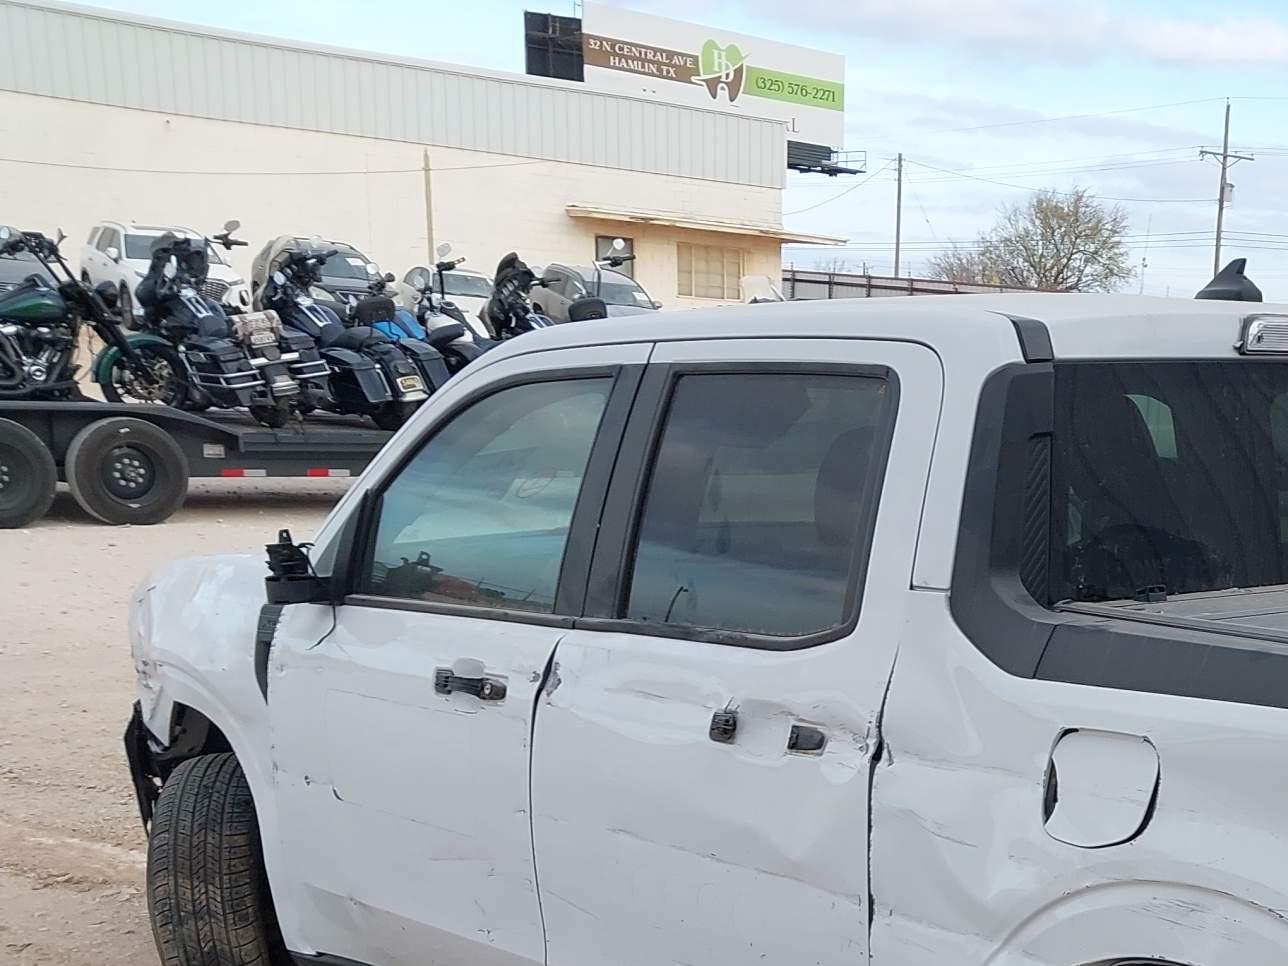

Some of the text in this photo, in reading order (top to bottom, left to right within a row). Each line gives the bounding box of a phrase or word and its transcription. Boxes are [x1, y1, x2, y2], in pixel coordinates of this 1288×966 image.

[615, 43, 670, 63] CENTRAL
[661, 65, 677, 78] TX
[755, 75, 837, 104] (325) 576-2271
